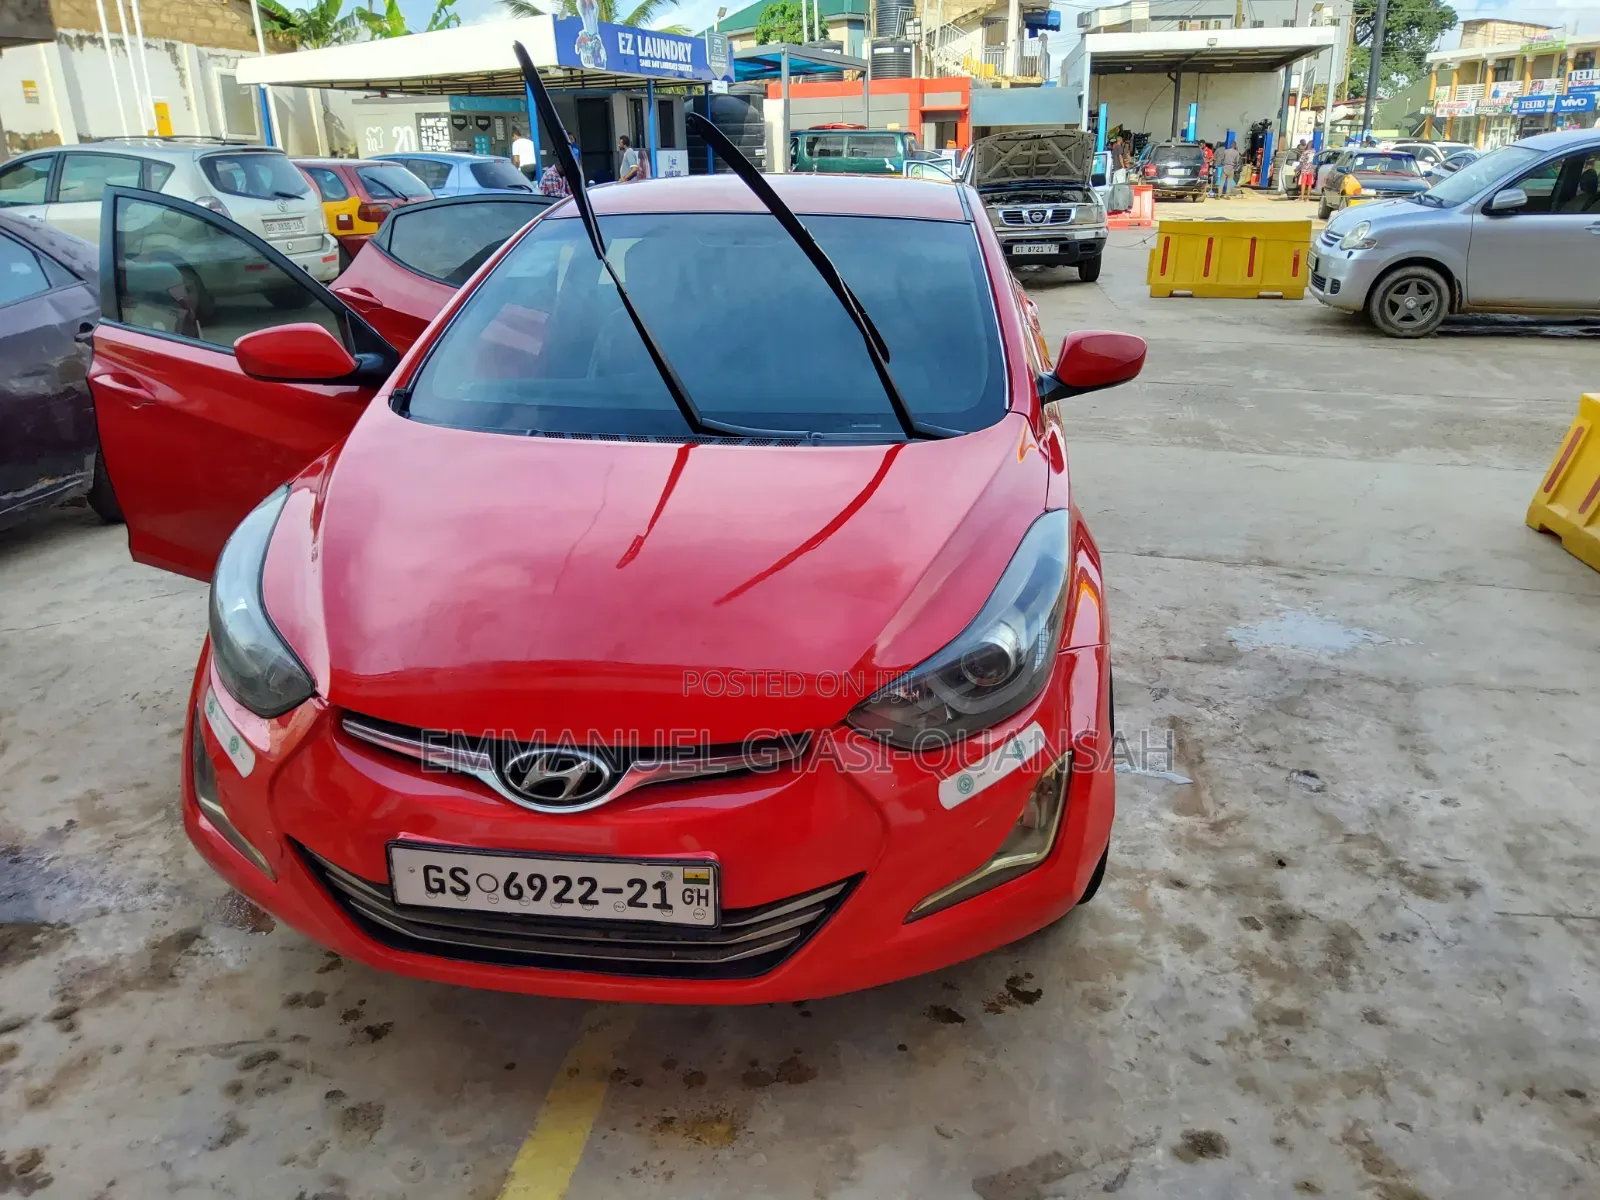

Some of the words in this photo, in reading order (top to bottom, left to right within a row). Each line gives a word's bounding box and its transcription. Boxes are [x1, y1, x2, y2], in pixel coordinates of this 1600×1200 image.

[617, 32, 635, 55] EZ
[637, 35, 692, 62] LAUNDRY
[423, 864, 471, 897] GS
[503, 871, 673, 911] 6922-21
[681, 888, 710, 907] GH
